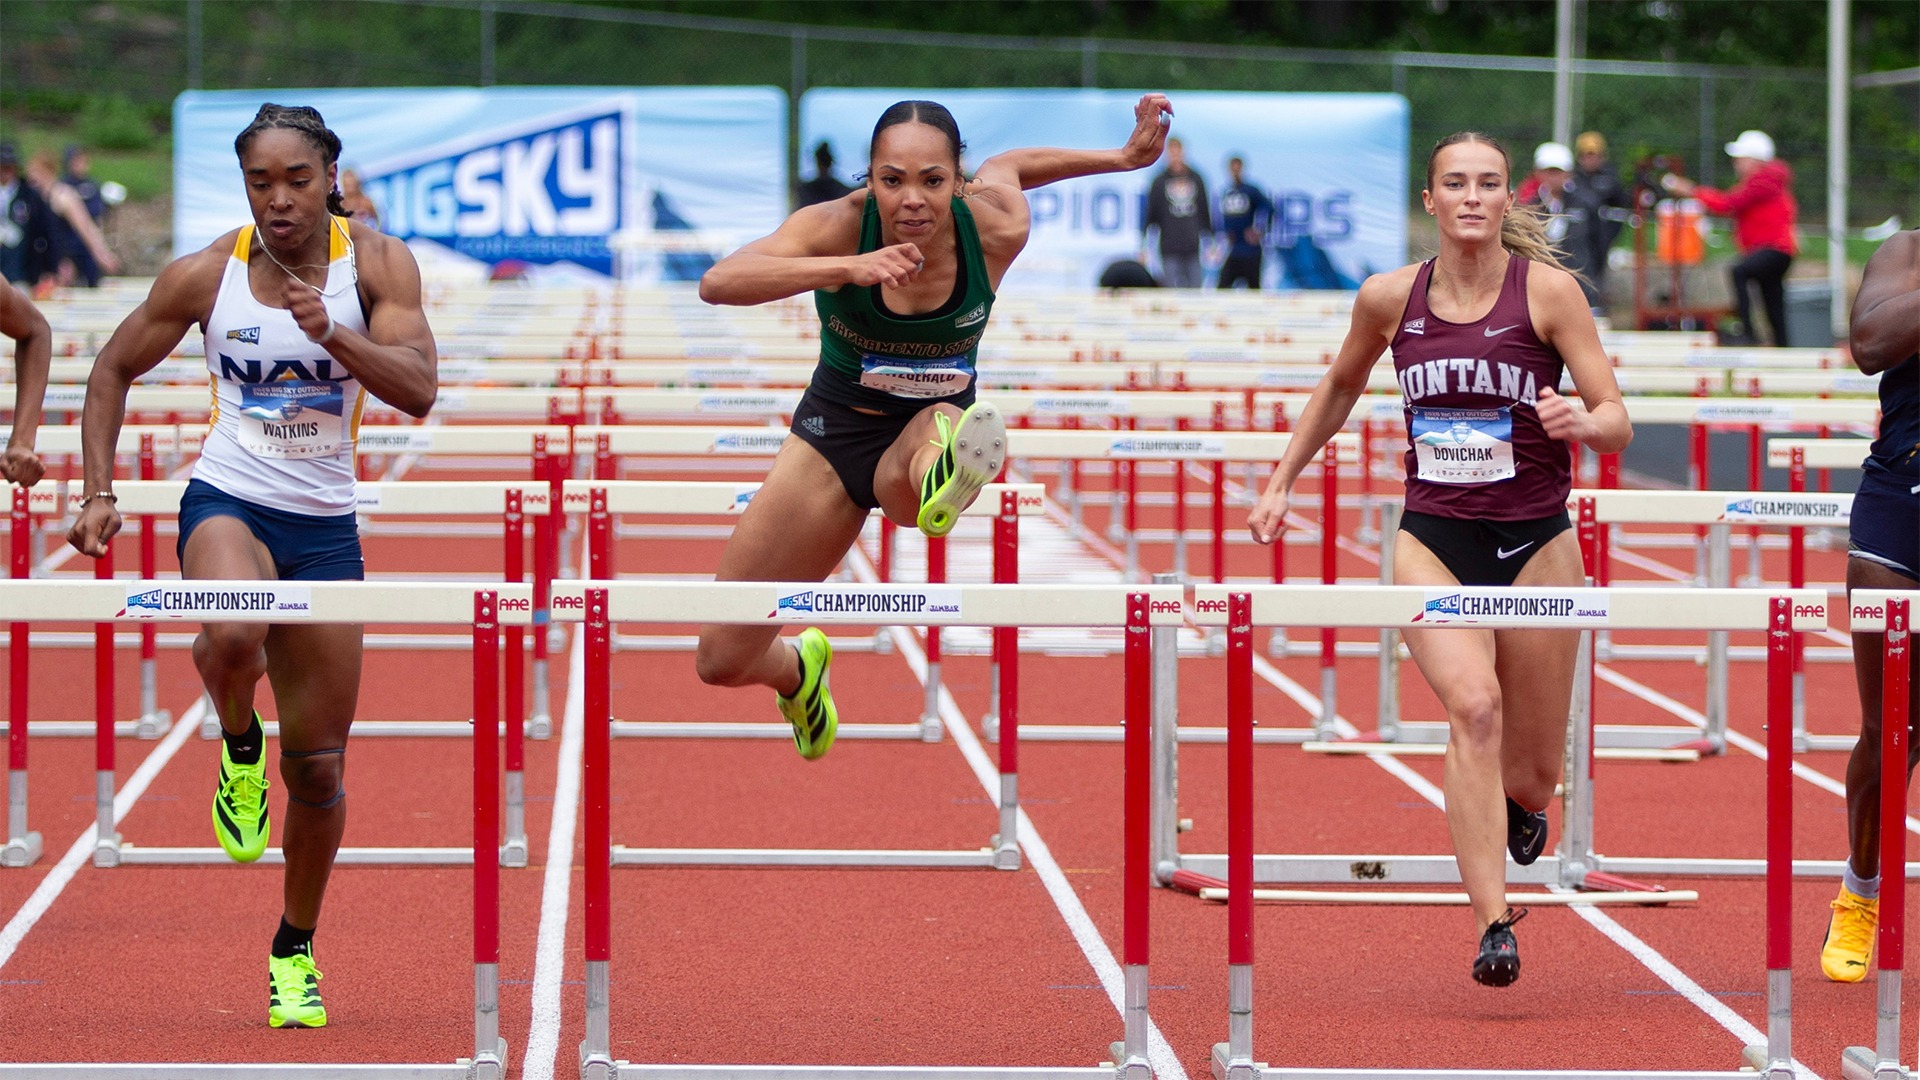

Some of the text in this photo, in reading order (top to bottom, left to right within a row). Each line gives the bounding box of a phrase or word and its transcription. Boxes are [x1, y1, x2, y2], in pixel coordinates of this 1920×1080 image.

[828, 315, 942, 357] SACRAMENTO
[262, 421, 319, 440] WATKINS
[801, 418, 826, 438] adidas
[1433, 447, 1493, 461] DOVICHAK
[1753, 501, 1839, 517] CHAMPIONSHIP
[164, 592, 275, 610] CHAMPIONSHIP
[815, 593, 926, 612] CHAMPIONSHIP
[1462, 597, 1574, 616] CHAMPIONSHIP
